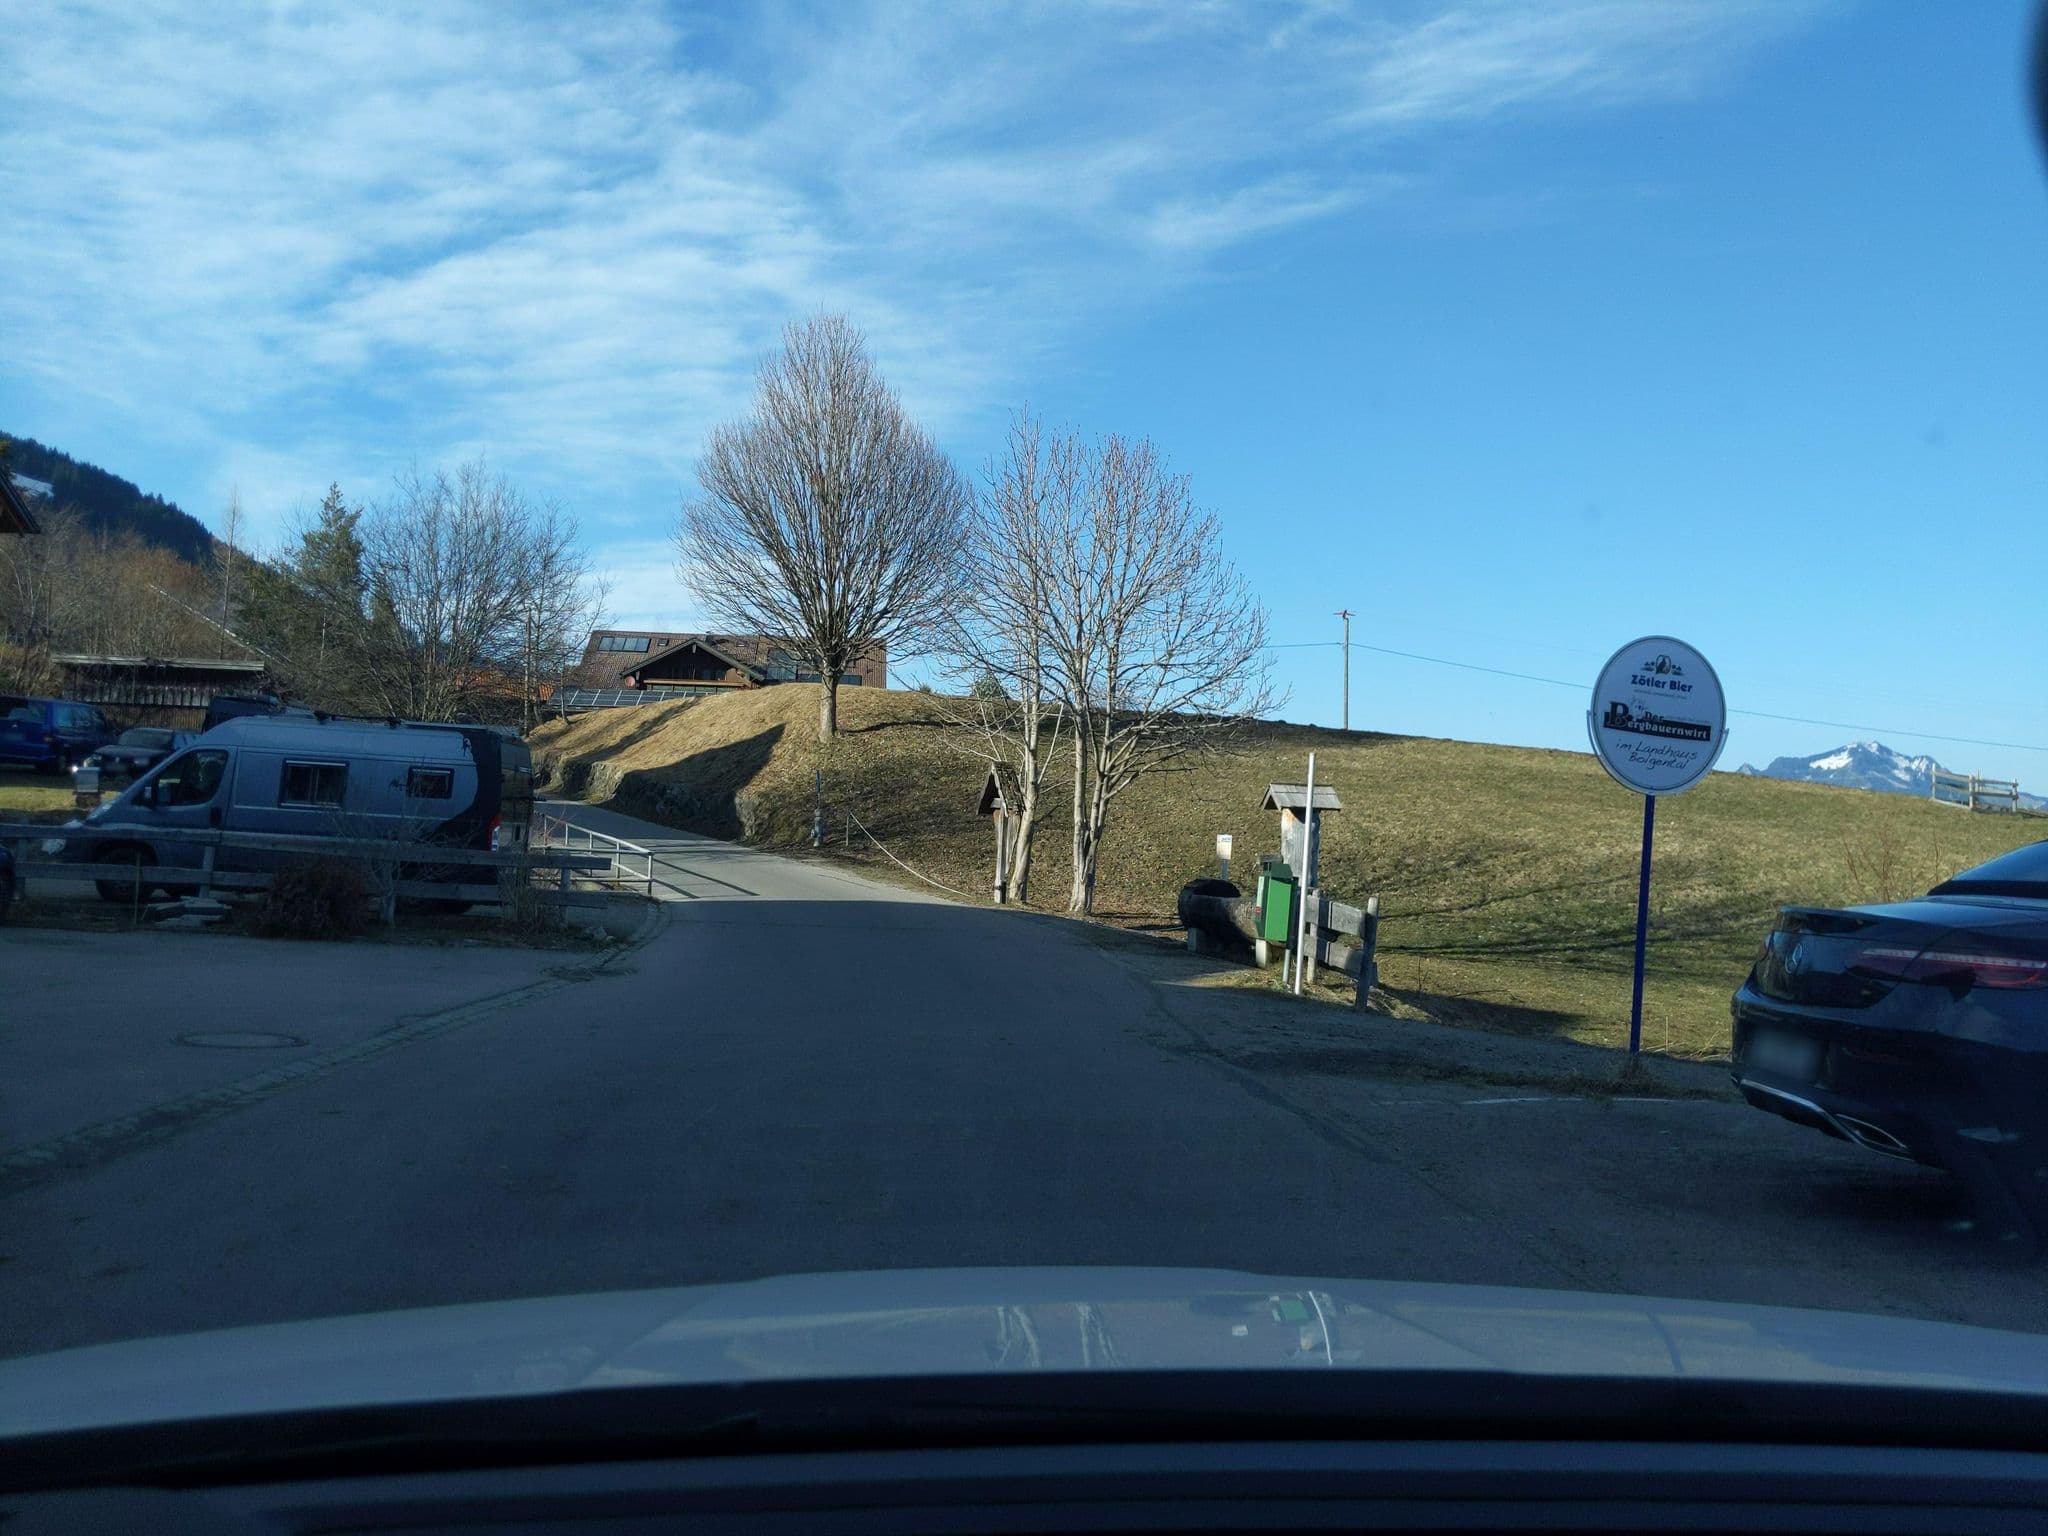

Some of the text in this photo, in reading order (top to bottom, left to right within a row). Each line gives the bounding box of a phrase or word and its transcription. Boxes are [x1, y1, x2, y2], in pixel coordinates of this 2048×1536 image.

[1631, 675, 1693, 693] Zötler Bier
[1607, 701, 1707, 739] Bergbauernwirt
[1616, 739, 1697, 760] im Landhaus
[1629, 752, 1689, 770] Bolgental
